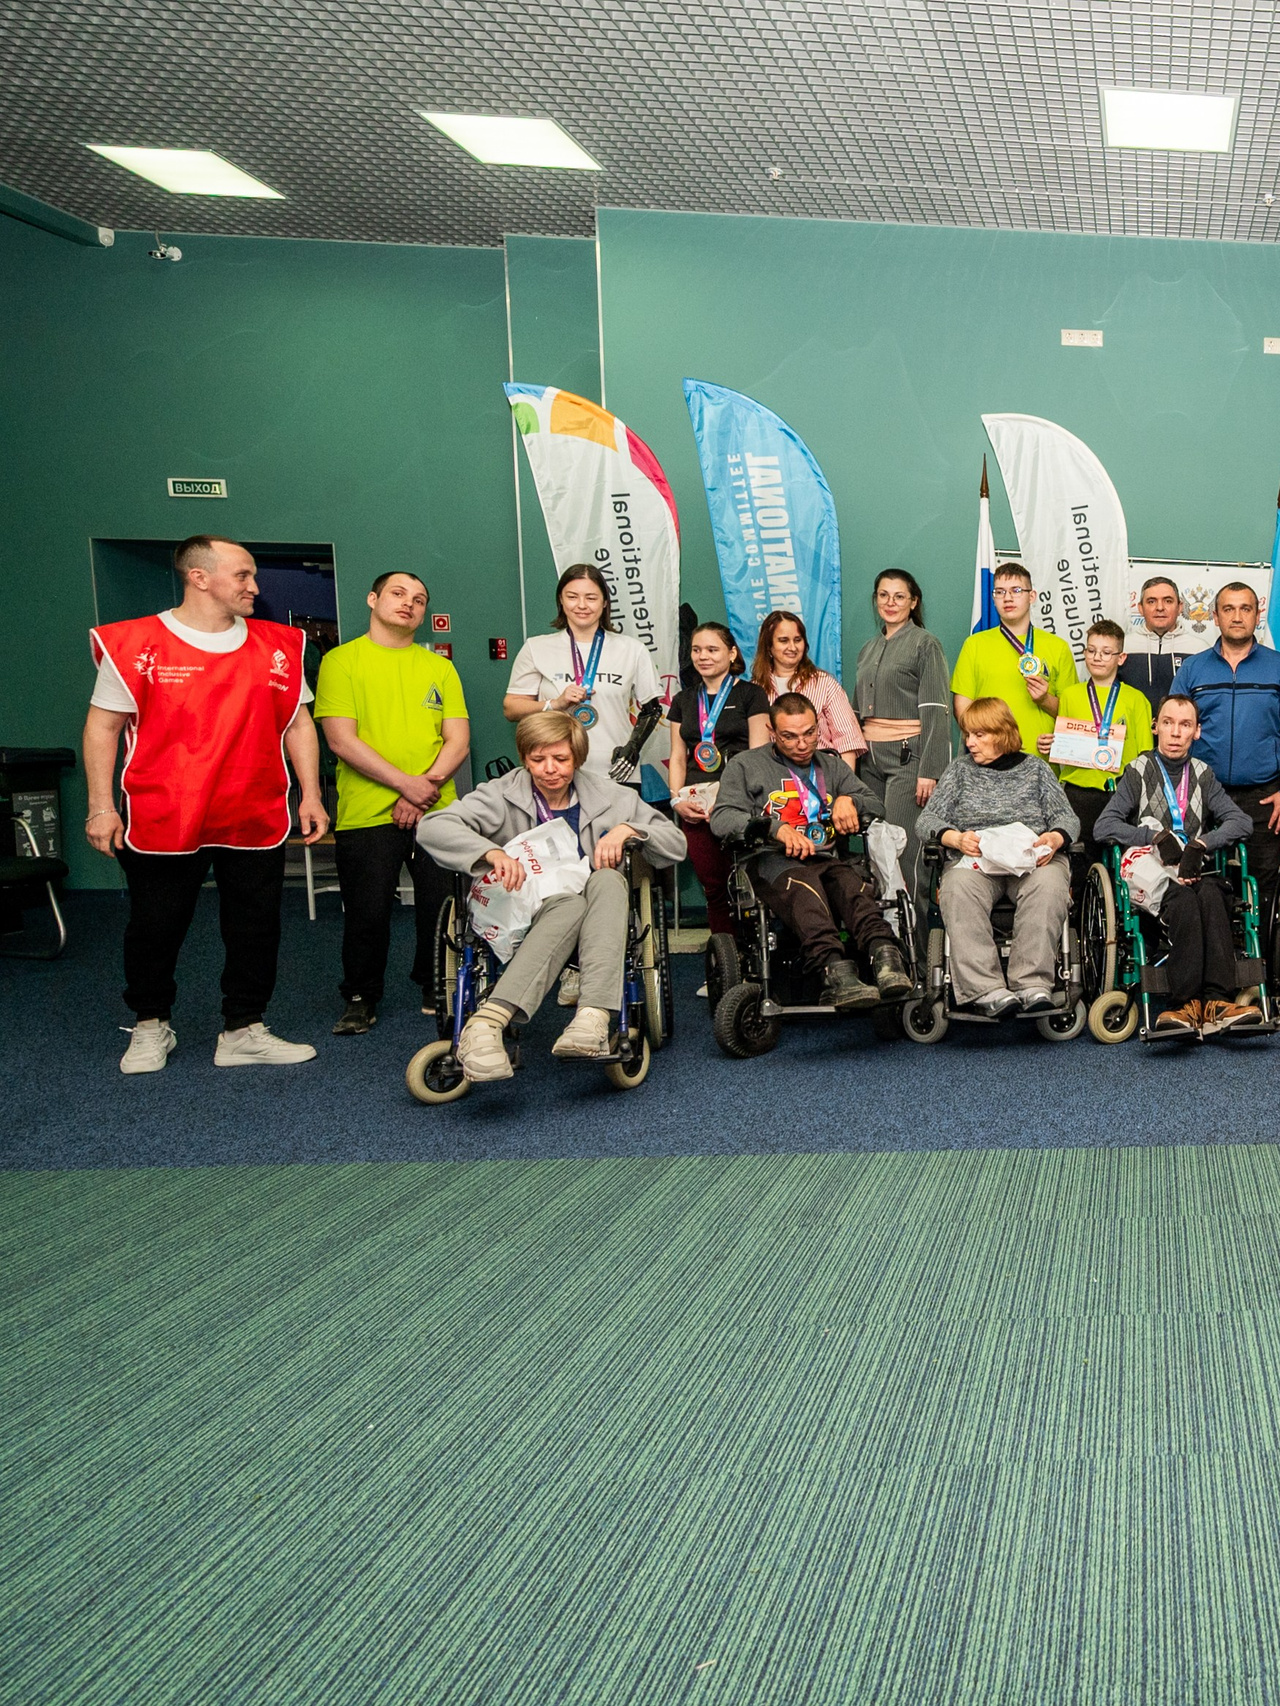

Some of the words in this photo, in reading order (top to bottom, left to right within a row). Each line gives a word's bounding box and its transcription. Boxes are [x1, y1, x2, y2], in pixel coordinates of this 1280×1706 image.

[175, 483, 220, 494] ВЫХОД
[565, 673, 623, 686] MTIZ
[1066, 722, 1115, 736] DIPLOA
